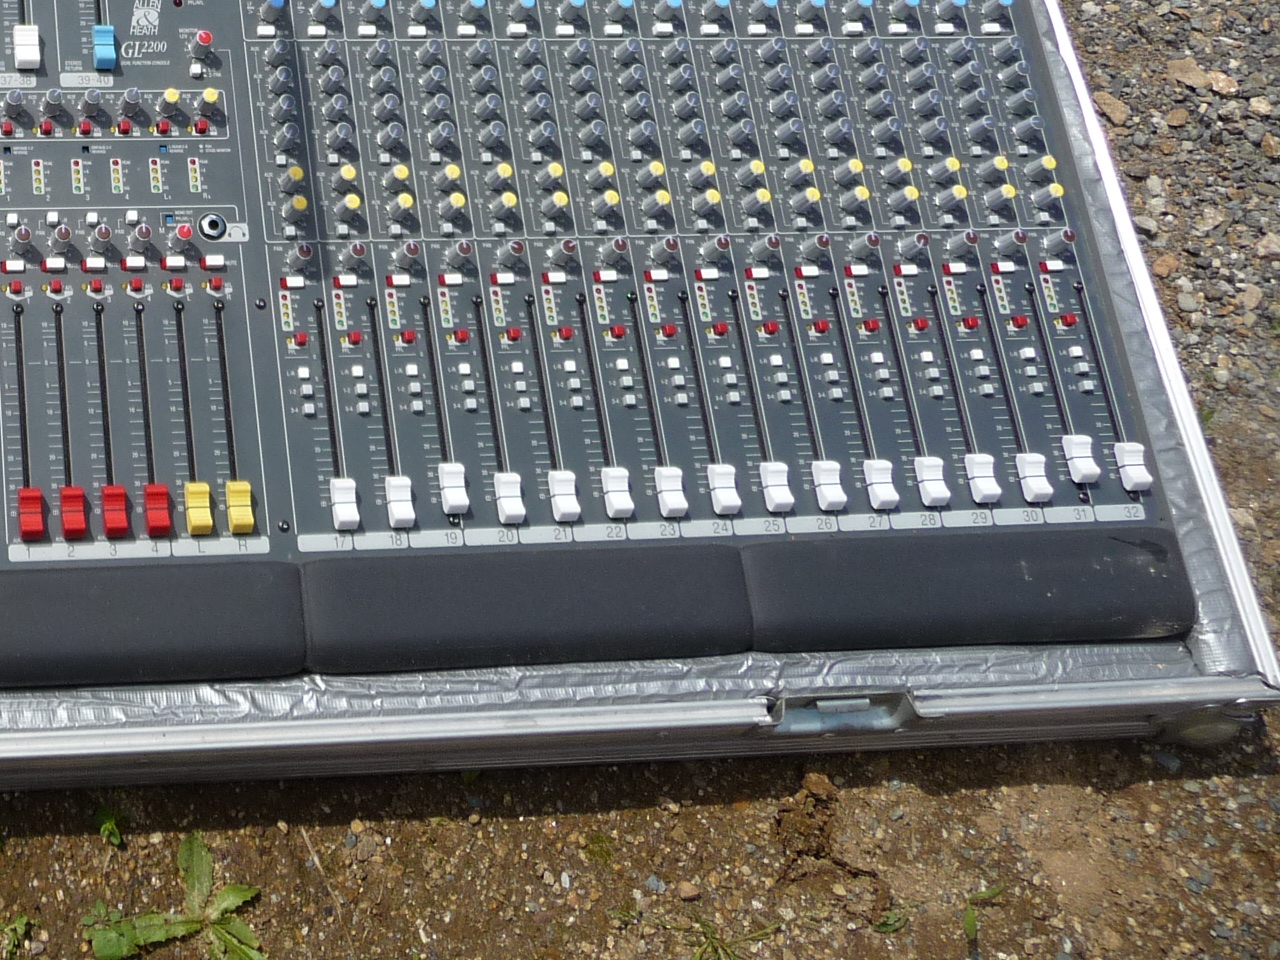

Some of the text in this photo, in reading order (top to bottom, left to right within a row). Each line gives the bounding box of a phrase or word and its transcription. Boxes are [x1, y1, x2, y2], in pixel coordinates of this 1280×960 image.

[134, 0, 162, 9] ALLEN
[130, 26, 158, 35] HEATH
[121, 41, 167, 58] GL2200
[1, 76, 32, 85] 37-38
[78, 75, 109, 84] 39-40
[972, 512, 988, 524] 29
[1023, 510, 1038, 522] 30
[1074, 508, 1087, 520] 31
[1124, 506, 1139, 518] 32
[764, 520, 780, 532] 25
[817, 518, 832, 530] 26
[869, 516, 884, 528] 27
[920, 514, 936, 526] 28
[553, 528, 567, 540] 21
[606, 526, 622, 539] 22
[660, 524, 676, 536] 23
[712, 523, 728, 535] 24
[334, 536, 346, 548] 17
[389, 534, 402, 547] 18
[445, 532, 457, 545] 19
[498, 530, 514, 542] 20
[67, 545, 75, 557] 2
[110, 545, 117, 556] 3
[152, 543, 159, 554] 4
[198, 541, 205, 553] L
[239, 540, 247, 551] R
[26, 547, 30, 558] 1
